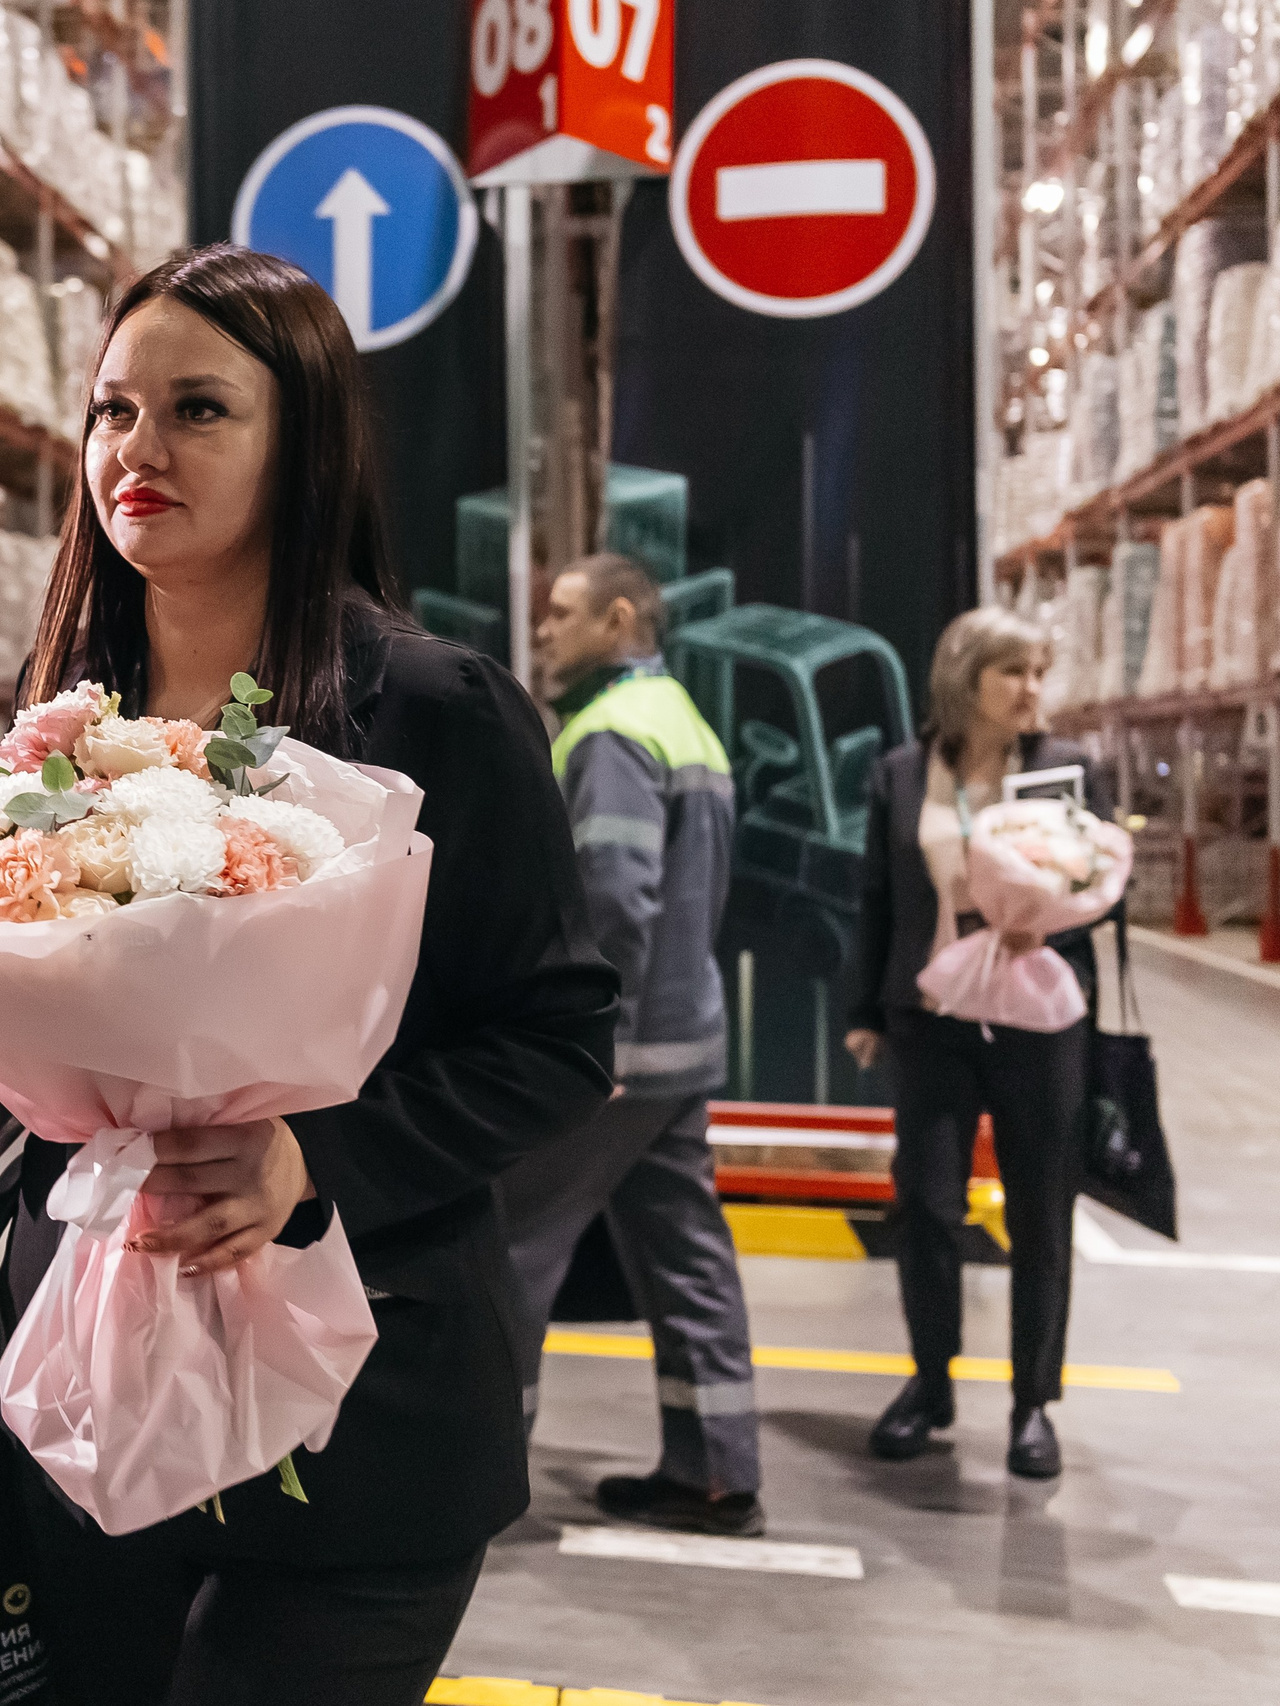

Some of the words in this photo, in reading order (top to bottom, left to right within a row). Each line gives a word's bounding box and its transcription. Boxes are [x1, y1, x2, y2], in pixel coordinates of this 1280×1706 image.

[471, 0, 554, 98] 08
[569, 0, 661, 83] 07
[538, 73, 559, 132] 1
[645, 103, 670, 164] 2
